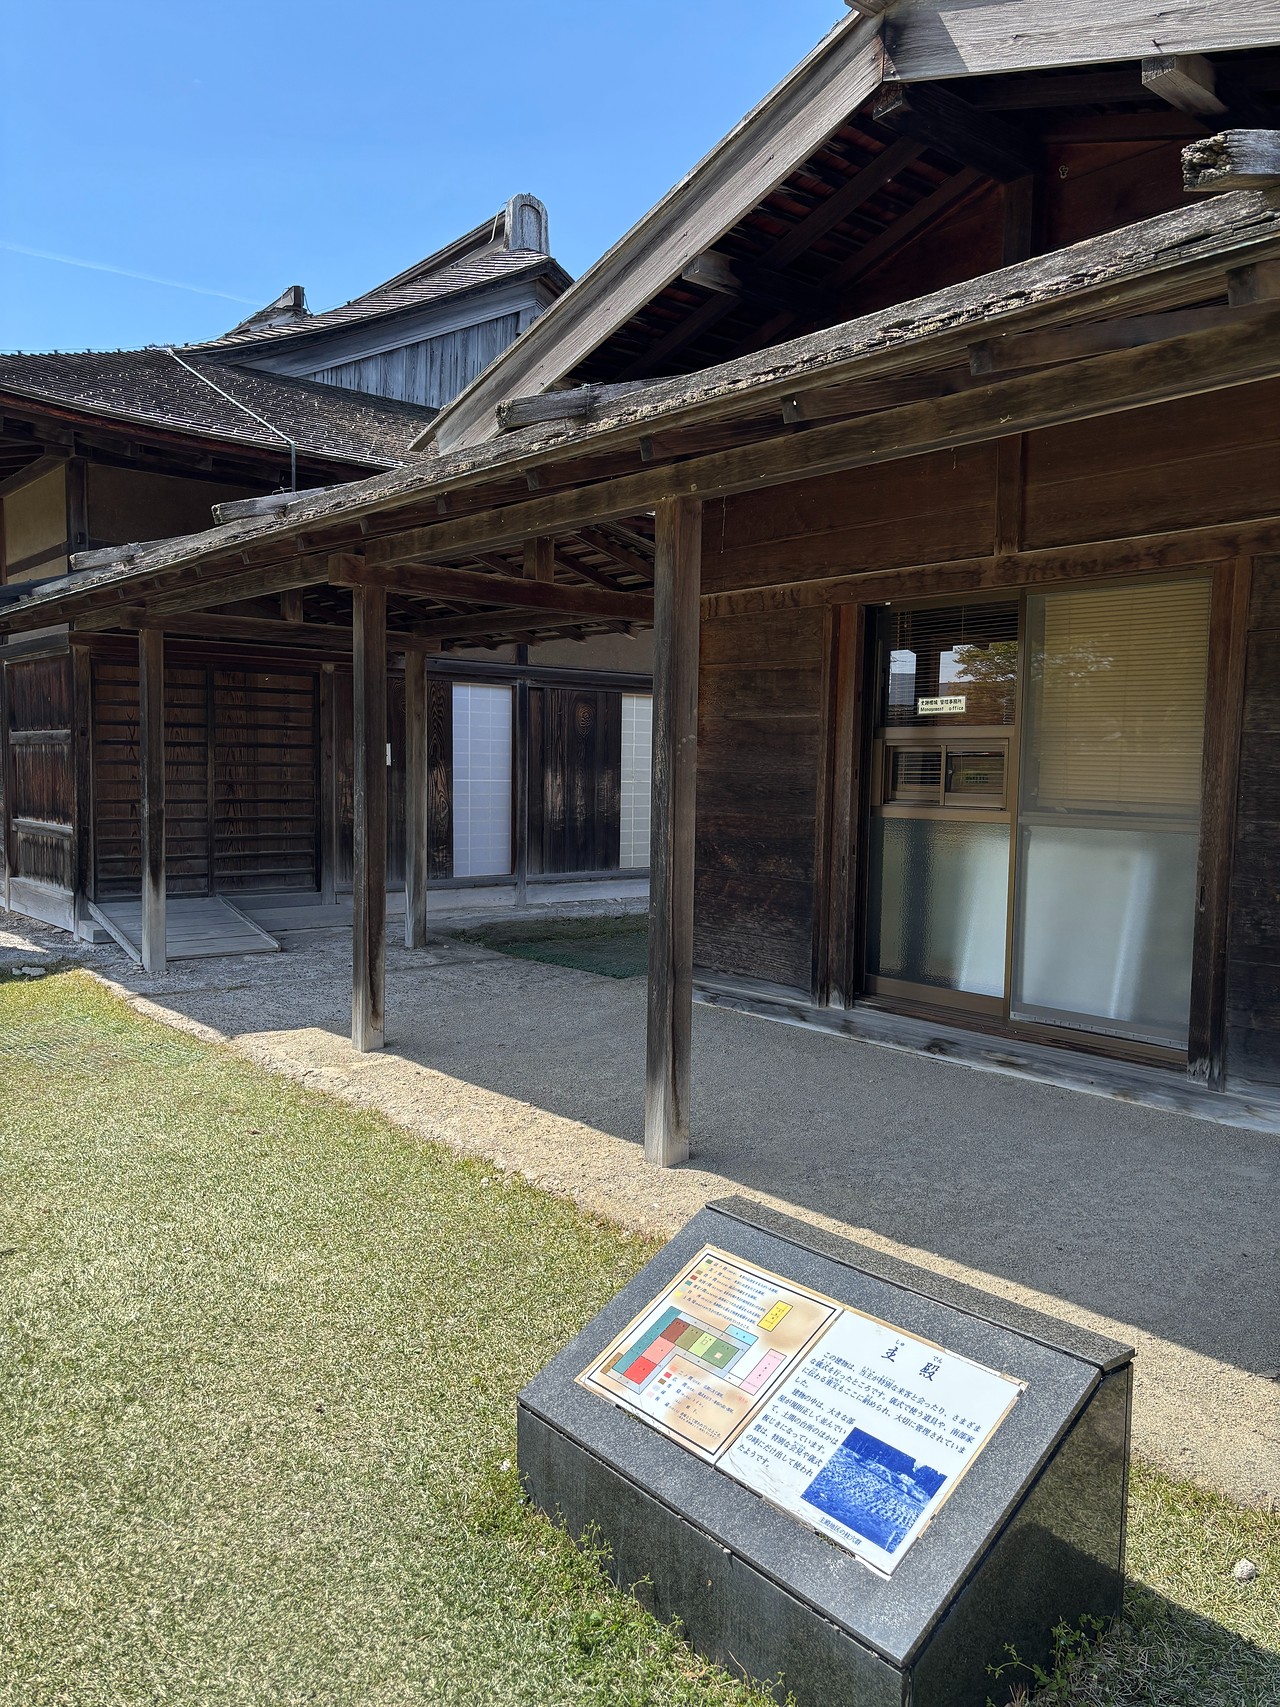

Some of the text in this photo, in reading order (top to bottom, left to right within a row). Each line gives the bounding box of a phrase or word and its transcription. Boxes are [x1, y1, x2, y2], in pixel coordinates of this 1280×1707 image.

[933, 1355, 943, 1364] でん
[794, 1376, 809, 1389] した。
[736, 1443, 770, 1468] たようです。
